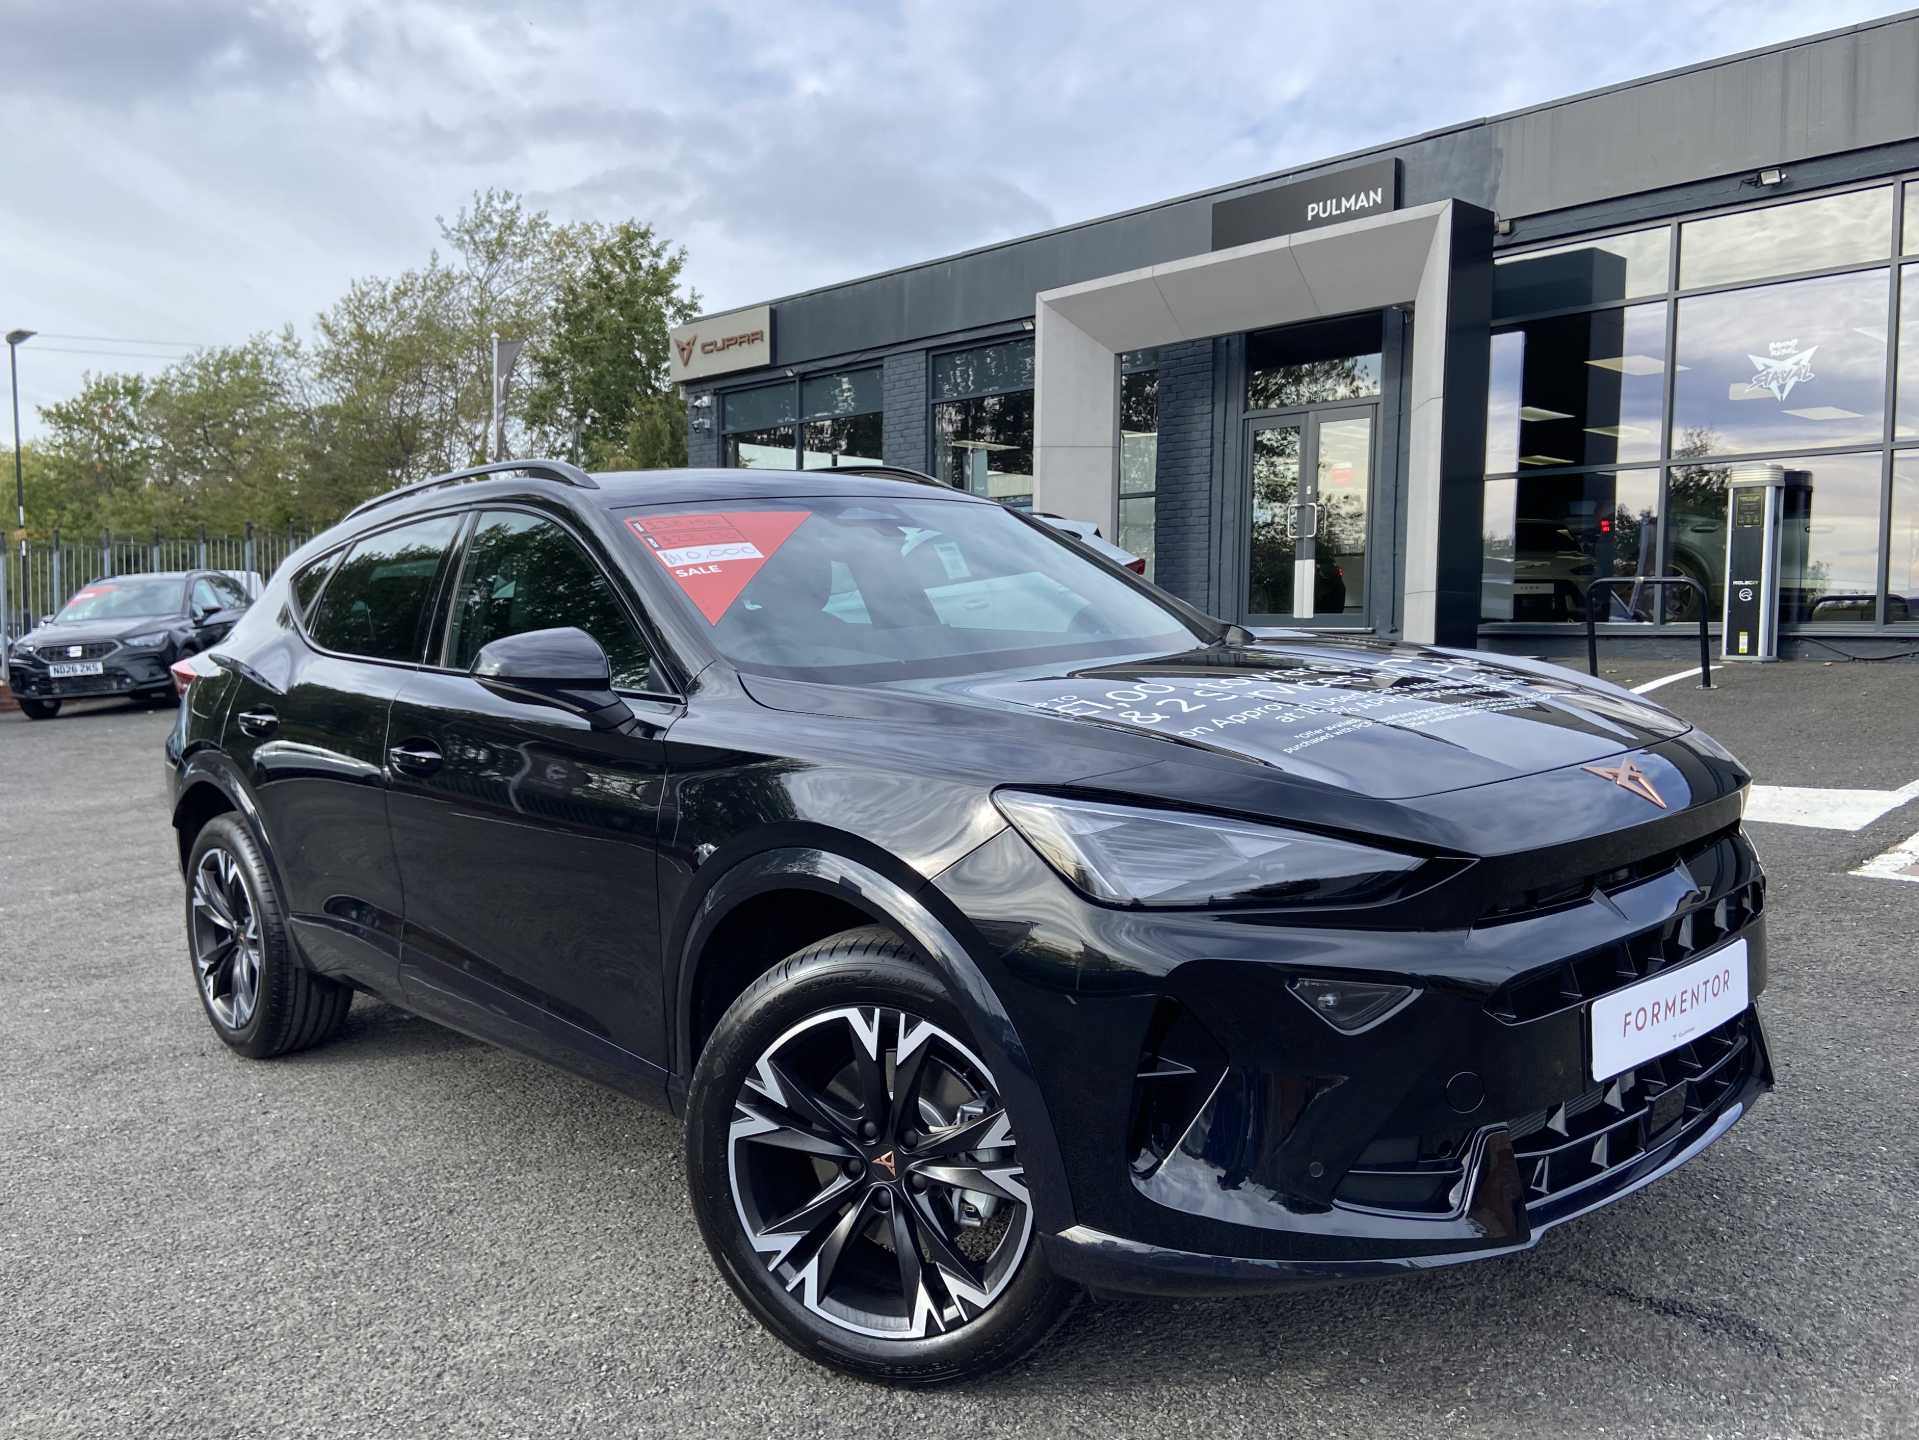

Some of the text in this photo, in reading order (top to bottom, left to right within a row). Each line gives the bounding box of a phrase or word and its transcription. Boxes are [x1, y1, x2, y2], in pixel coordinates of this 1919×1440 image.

[1307, 187, 1383, 221] PULMAN
[701, 329, 765, 355] CUPRA
[675, 564, 722, 578] SALE
[1118, 710, 1170, 724] &
[1156, 698, 1207, 713] 2
[1193, 674, 1371, 702] Srvices
[1178, 725, 1215, 737] on
[1311, 692, 1368, 706] Used
[1275, 712, 1306, 723] at
[1623, 969, 1730, 1038] FORMENTOR
